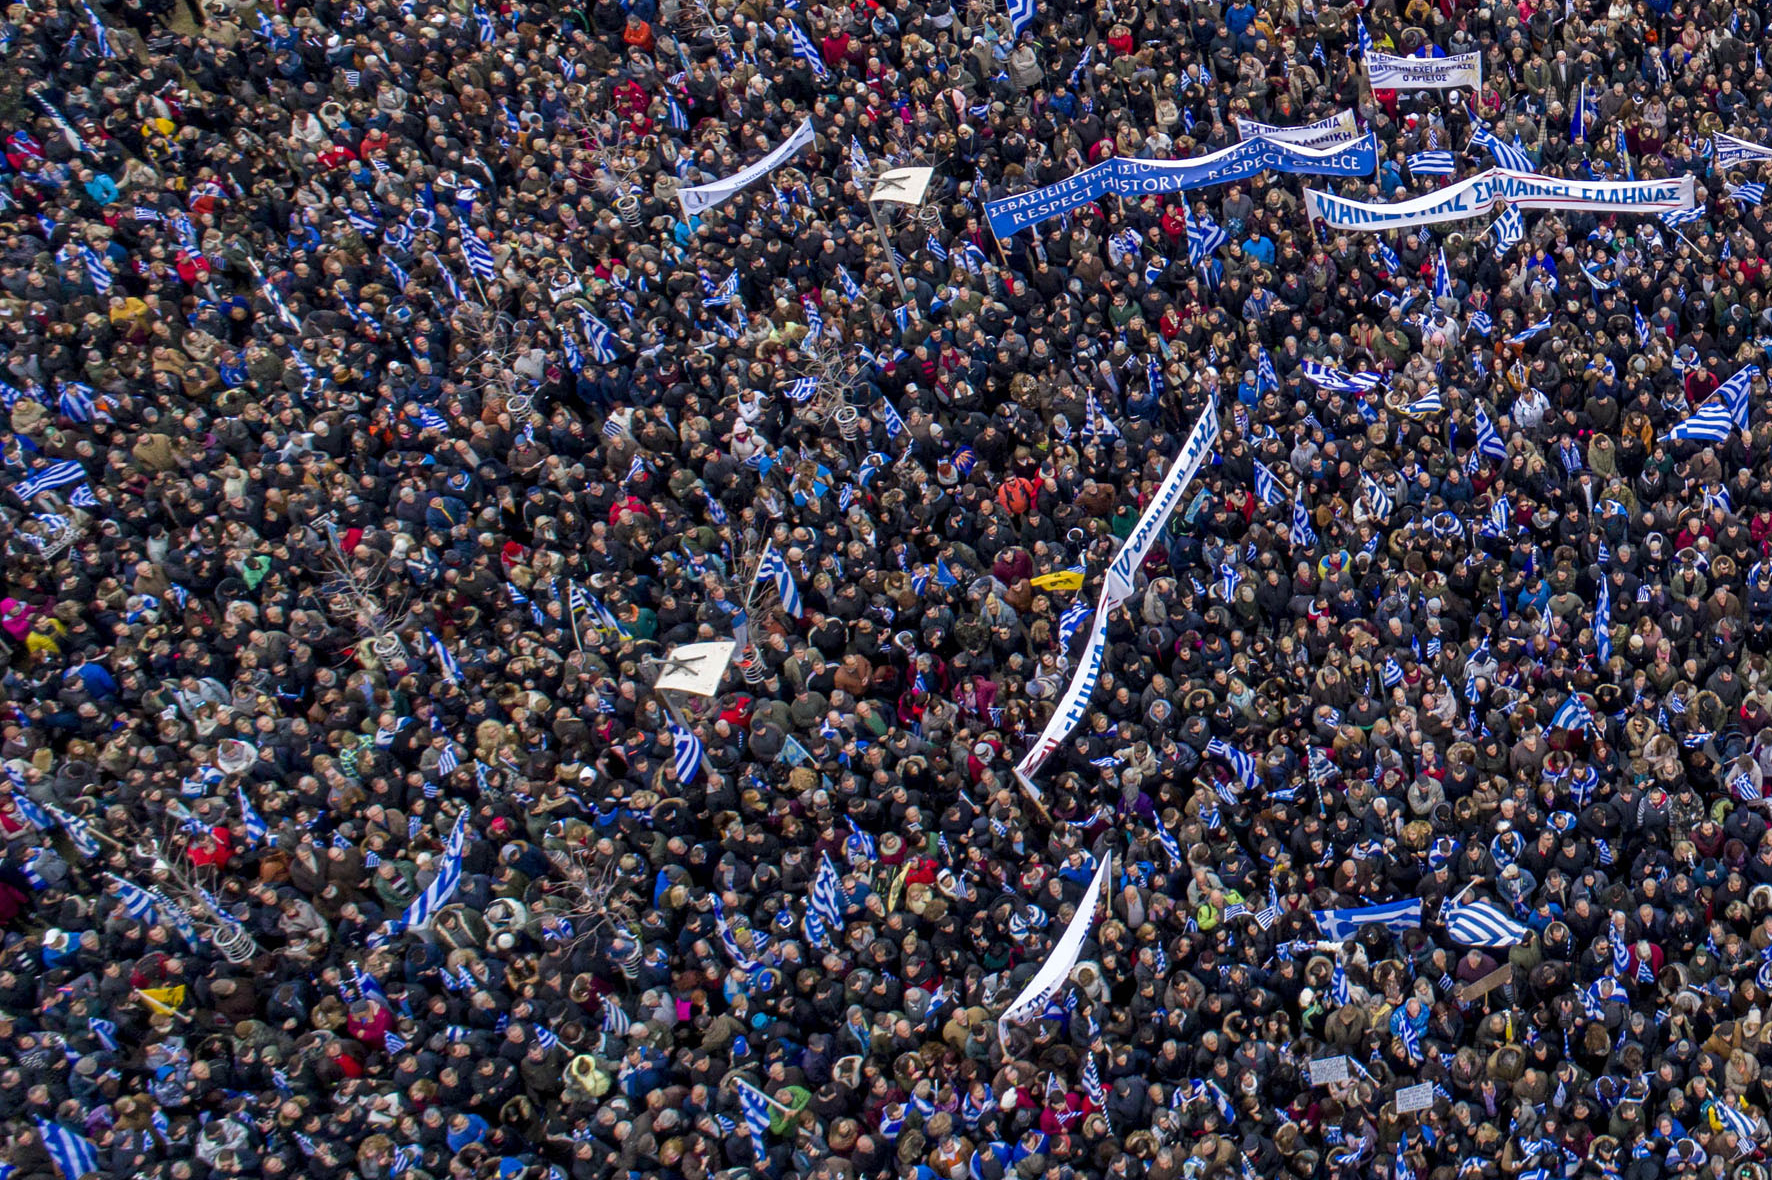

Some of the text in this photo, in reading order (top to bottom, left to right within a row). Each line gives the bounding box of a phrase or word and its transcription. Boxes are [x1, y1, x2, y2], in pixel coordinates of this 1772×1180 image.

[1402, 74, 1409, 82] Ο
[1413, 65, 1434, 74] ΕΧΕΙ
[990, 177, 1080, 218] ΣΕΒΑΣΤΕΙΤΕ
[1082, 163, 1113, 186] ΤΗΝ
[1013, 186, 1093, 225] RESPECT
[1100, 173, 1186, 193] HISTORY
[1208, 151, 1284, 181] RESPECT
[1474, 180, 1570, 205] ΣΗΜΑΙΝΕΙ
[1581, 186, 1681, 204] ΕΛΛΗΝΑΣ
